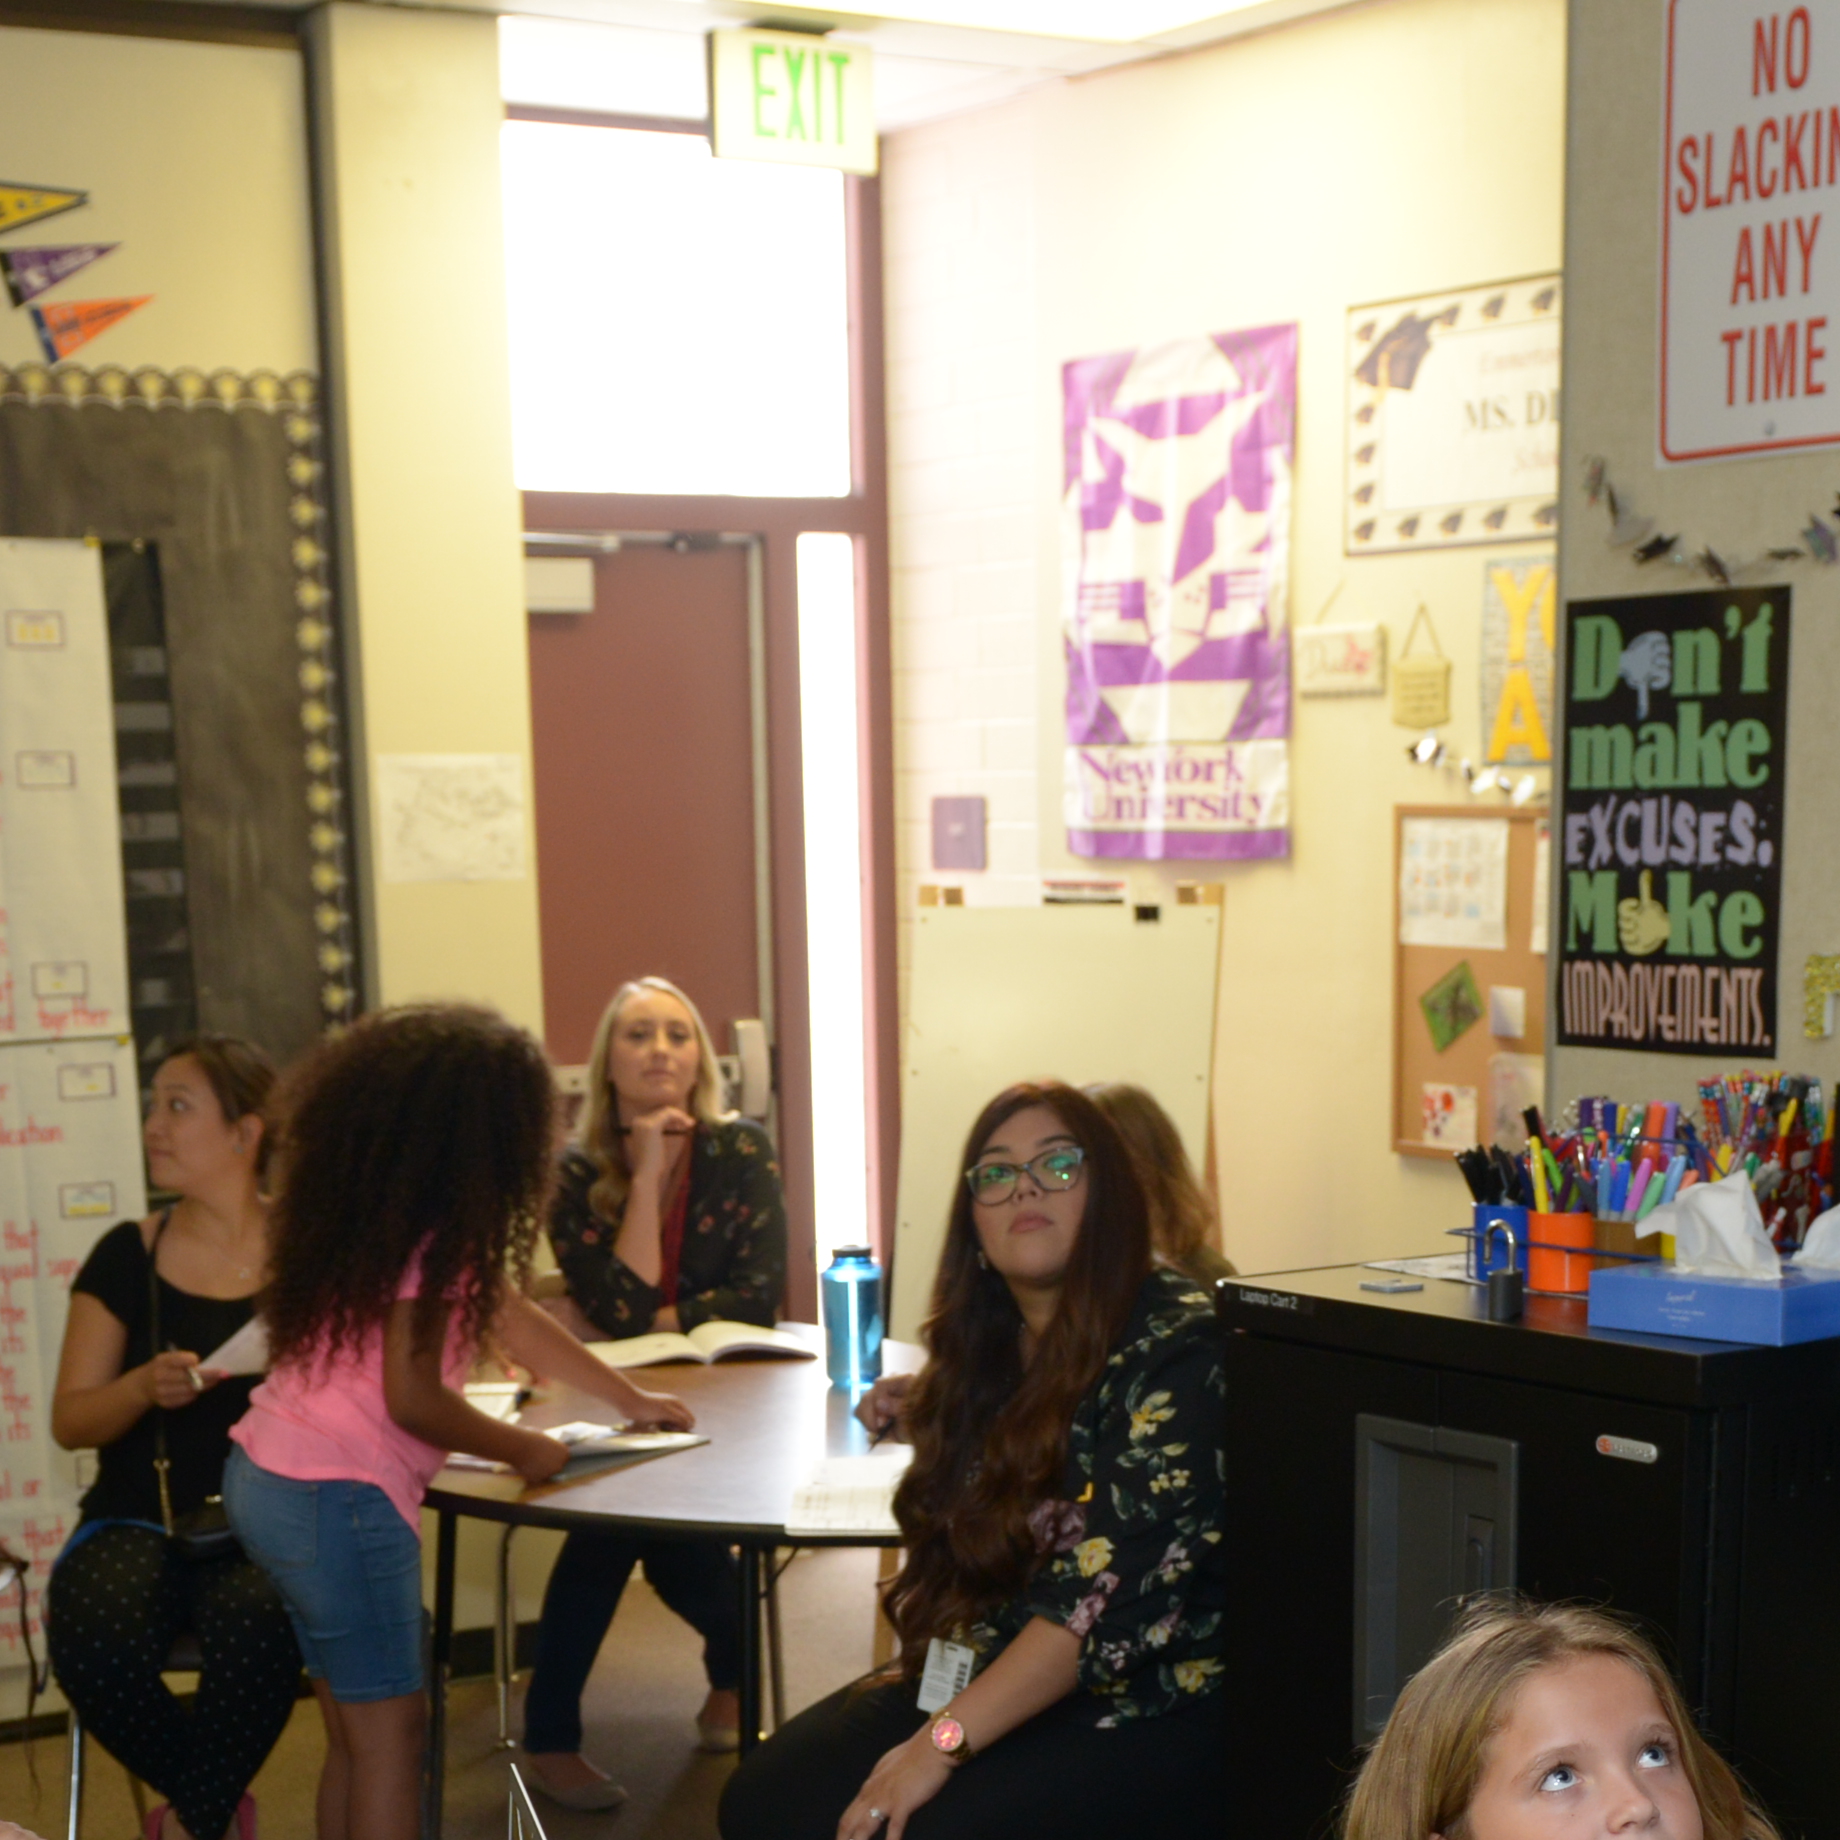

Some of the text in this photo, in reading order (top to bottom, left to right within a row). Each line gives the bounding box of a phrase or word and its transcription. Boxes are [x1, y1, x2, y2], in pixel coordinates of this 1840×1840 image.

[751, 43, 850, 147] EXIT
[1751, 7, 1811, 98] NO
[1731, 213, 1823, 306] ANY
[1721, 316, 1829, 407] TIME
[1163, 746, 1245, 789] ork
[1568, 701, 1771, 790] make
[1564, 795, 1774, 871] EXCUSES.
[1563, 959, 1771, 1047] IMPROVEMENTS.
[1240, 1288, 1298, 1309] Laptop Cart 2
